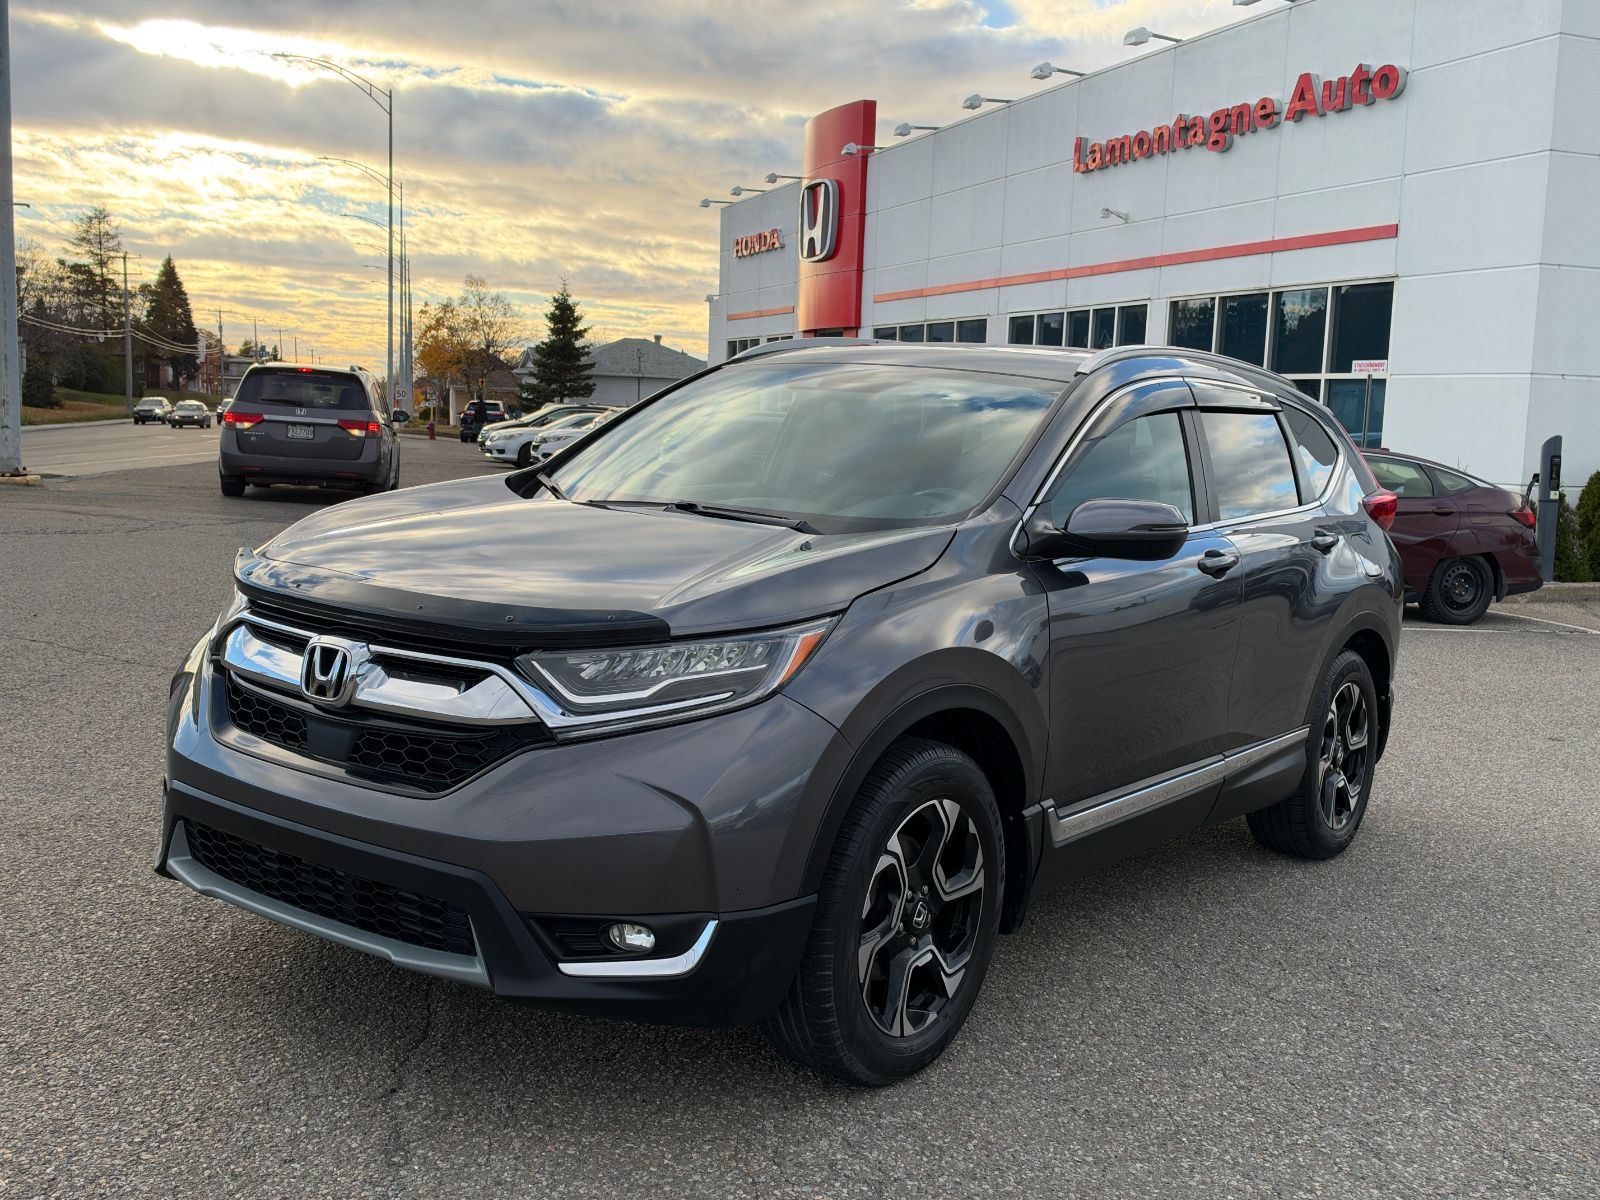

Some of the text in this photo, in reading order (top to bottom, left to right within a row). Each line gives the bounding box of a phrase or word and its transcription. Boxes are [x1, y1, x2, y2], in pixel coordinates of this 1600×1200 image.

[1073, 63, 1405, 174] Lamontagne Auto
[732, 228, 783, 258] HONDA
[396, 390, 406, 398] 50
